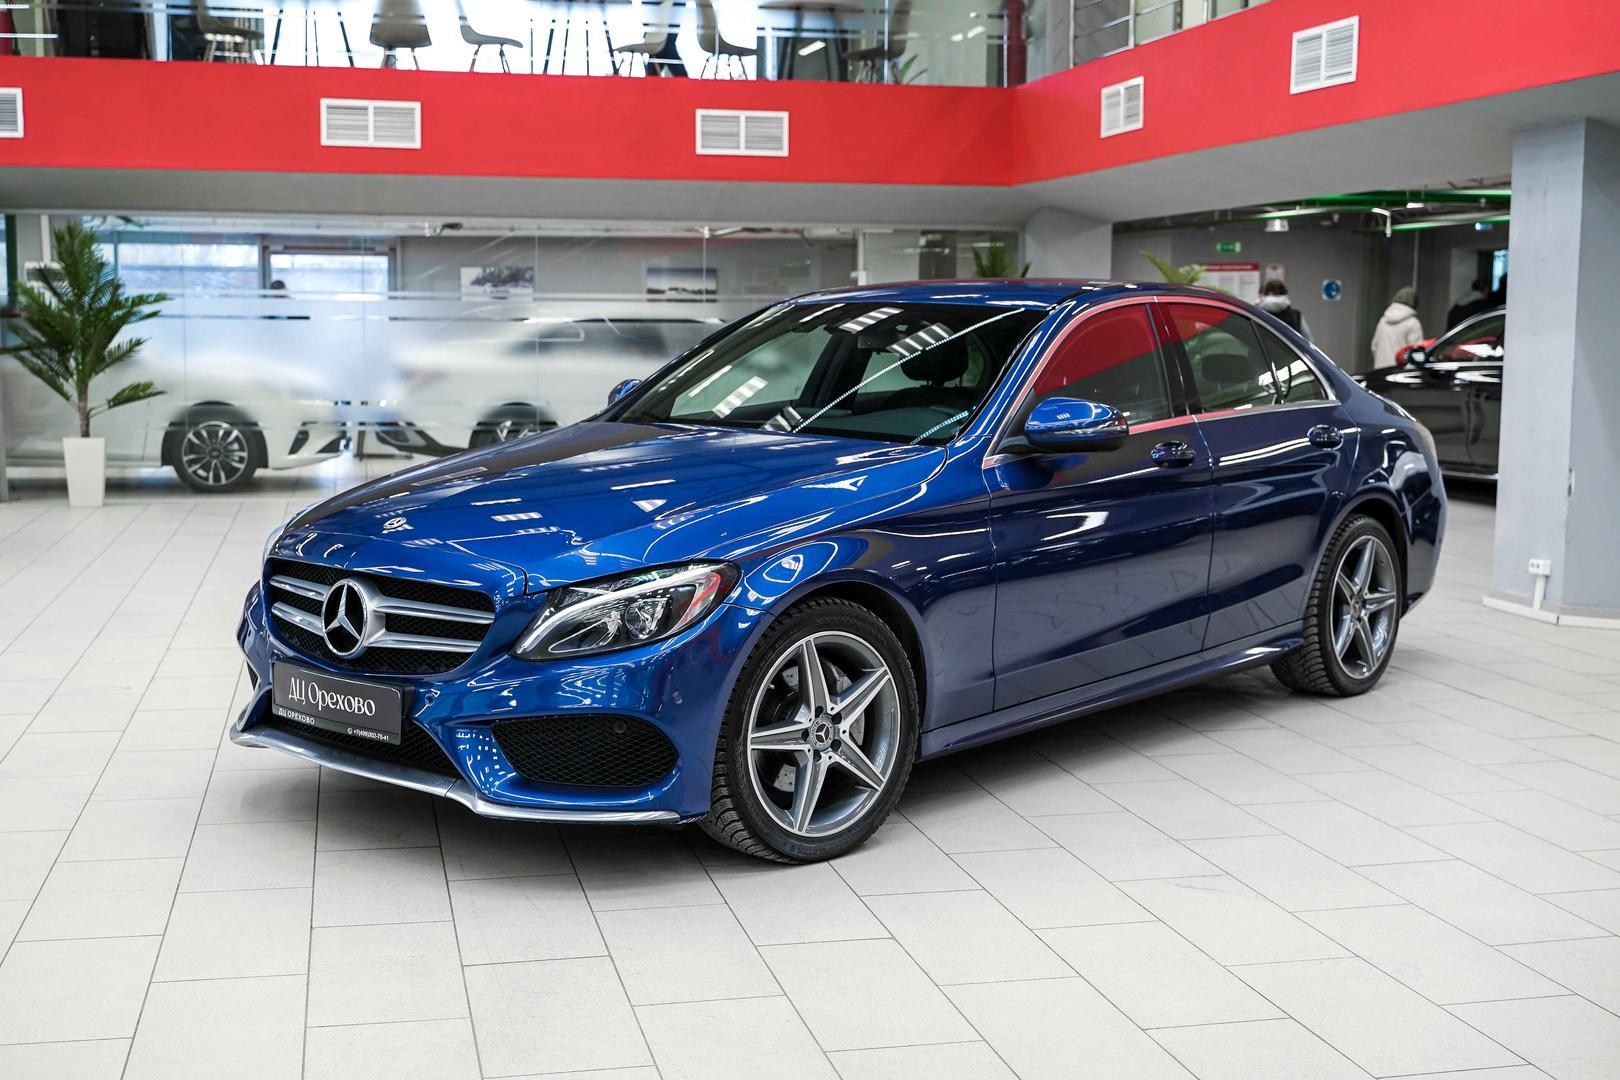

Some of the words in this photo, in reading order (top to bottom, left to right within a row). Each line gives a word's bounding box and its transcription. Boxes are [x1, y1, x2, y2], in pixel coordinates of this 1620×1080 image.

[289, 677, 306, 705] ДЦ
[308, 682, 375, 716] Орехово
[278, 708, 287, 717] ДЦ
[287, 710, 315, 725] ОРЕХОВО
